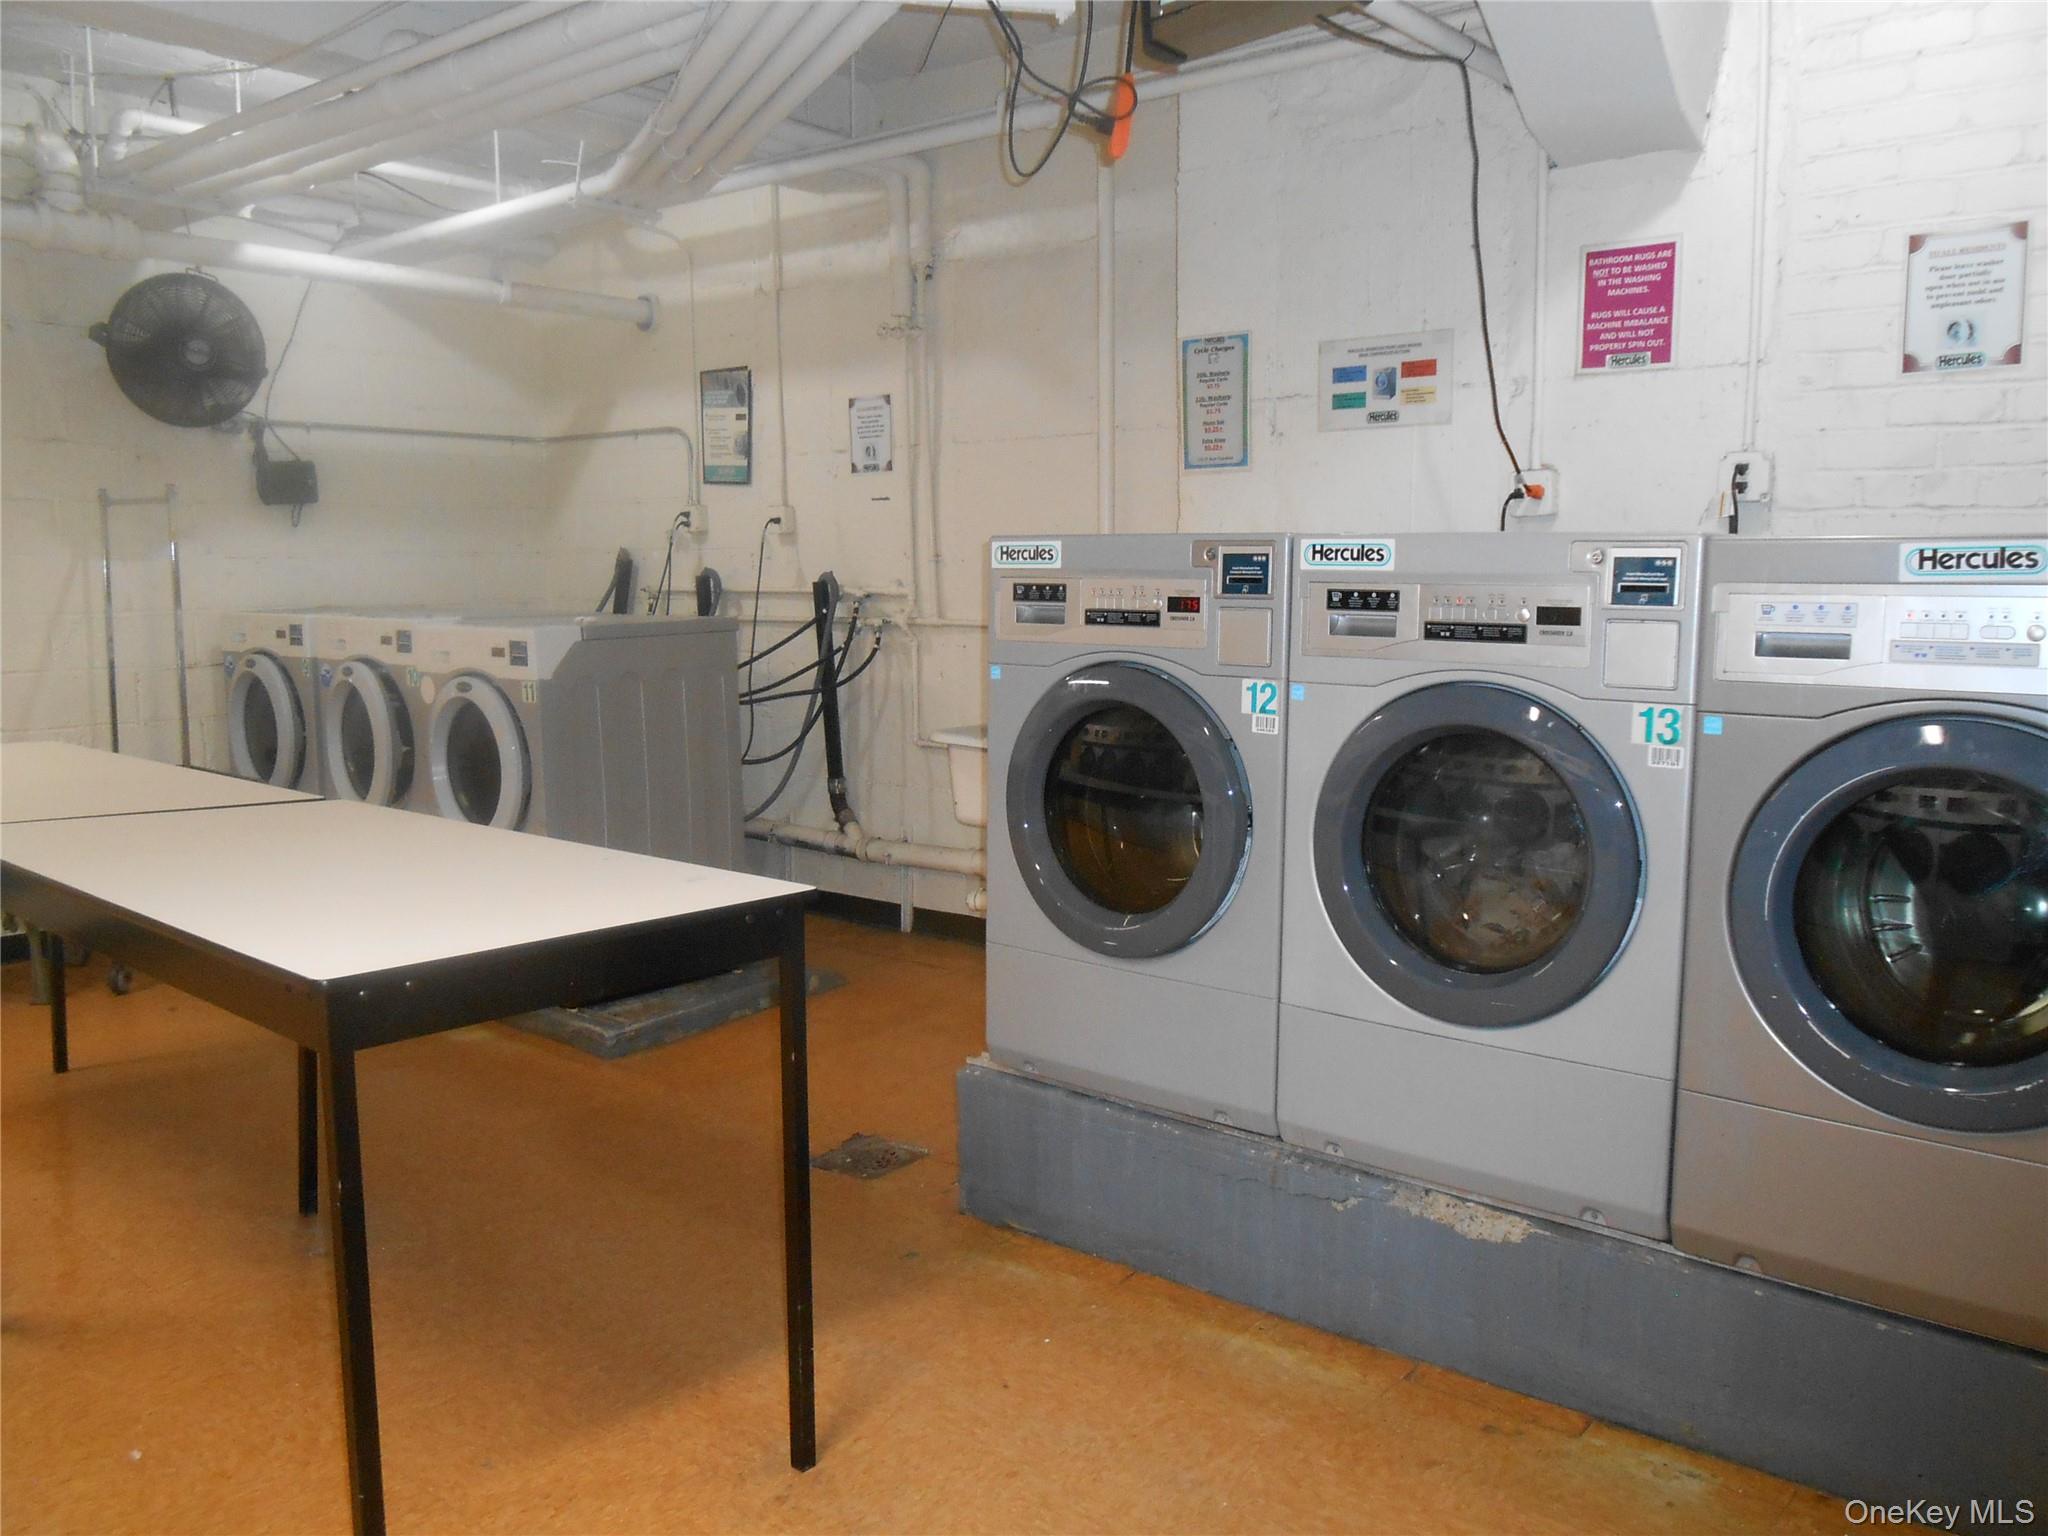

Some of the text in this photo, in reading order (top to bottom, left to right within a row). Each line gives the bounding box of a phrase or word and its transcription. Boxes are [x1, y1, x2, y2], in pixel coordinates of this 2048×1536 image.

[1589, 249, 1672, 266] BATHROOM RUGS ARE
[1593, 269, 1609, 278] NOT
[1622, 265, 1632, 273] BE
[1634, 261, 1668, 272] WASHED
[1598, 273, 1662, 287] IN THE WASHING
[1607, 286, 1650, 296] MACHINES.
[1591, 311, 1611, 319] RUGS
[1613, 309, 1631, 318] WILL
[1633, 306, 1658, 316] CAUSE
[1587, 316, 1669, 330] MACHINE IMBALANCE
[1600, 328, 1655, 340] AND WILL NOT
[1589, 338, 1665, 352] PROPERLY SPIN OUT.
[1611, 354, 1647, 367] Hercules
[1939, 353, 1982, 367] Hercules
[1000, 545, 1054, 562] Hercules
[1311, 543, 1385, 563] Hercules
[1918, 547, 2039, 570] Hercules
[1246, 682, 1277, 715] 12
[1639, 706, 1681, 745] 13
